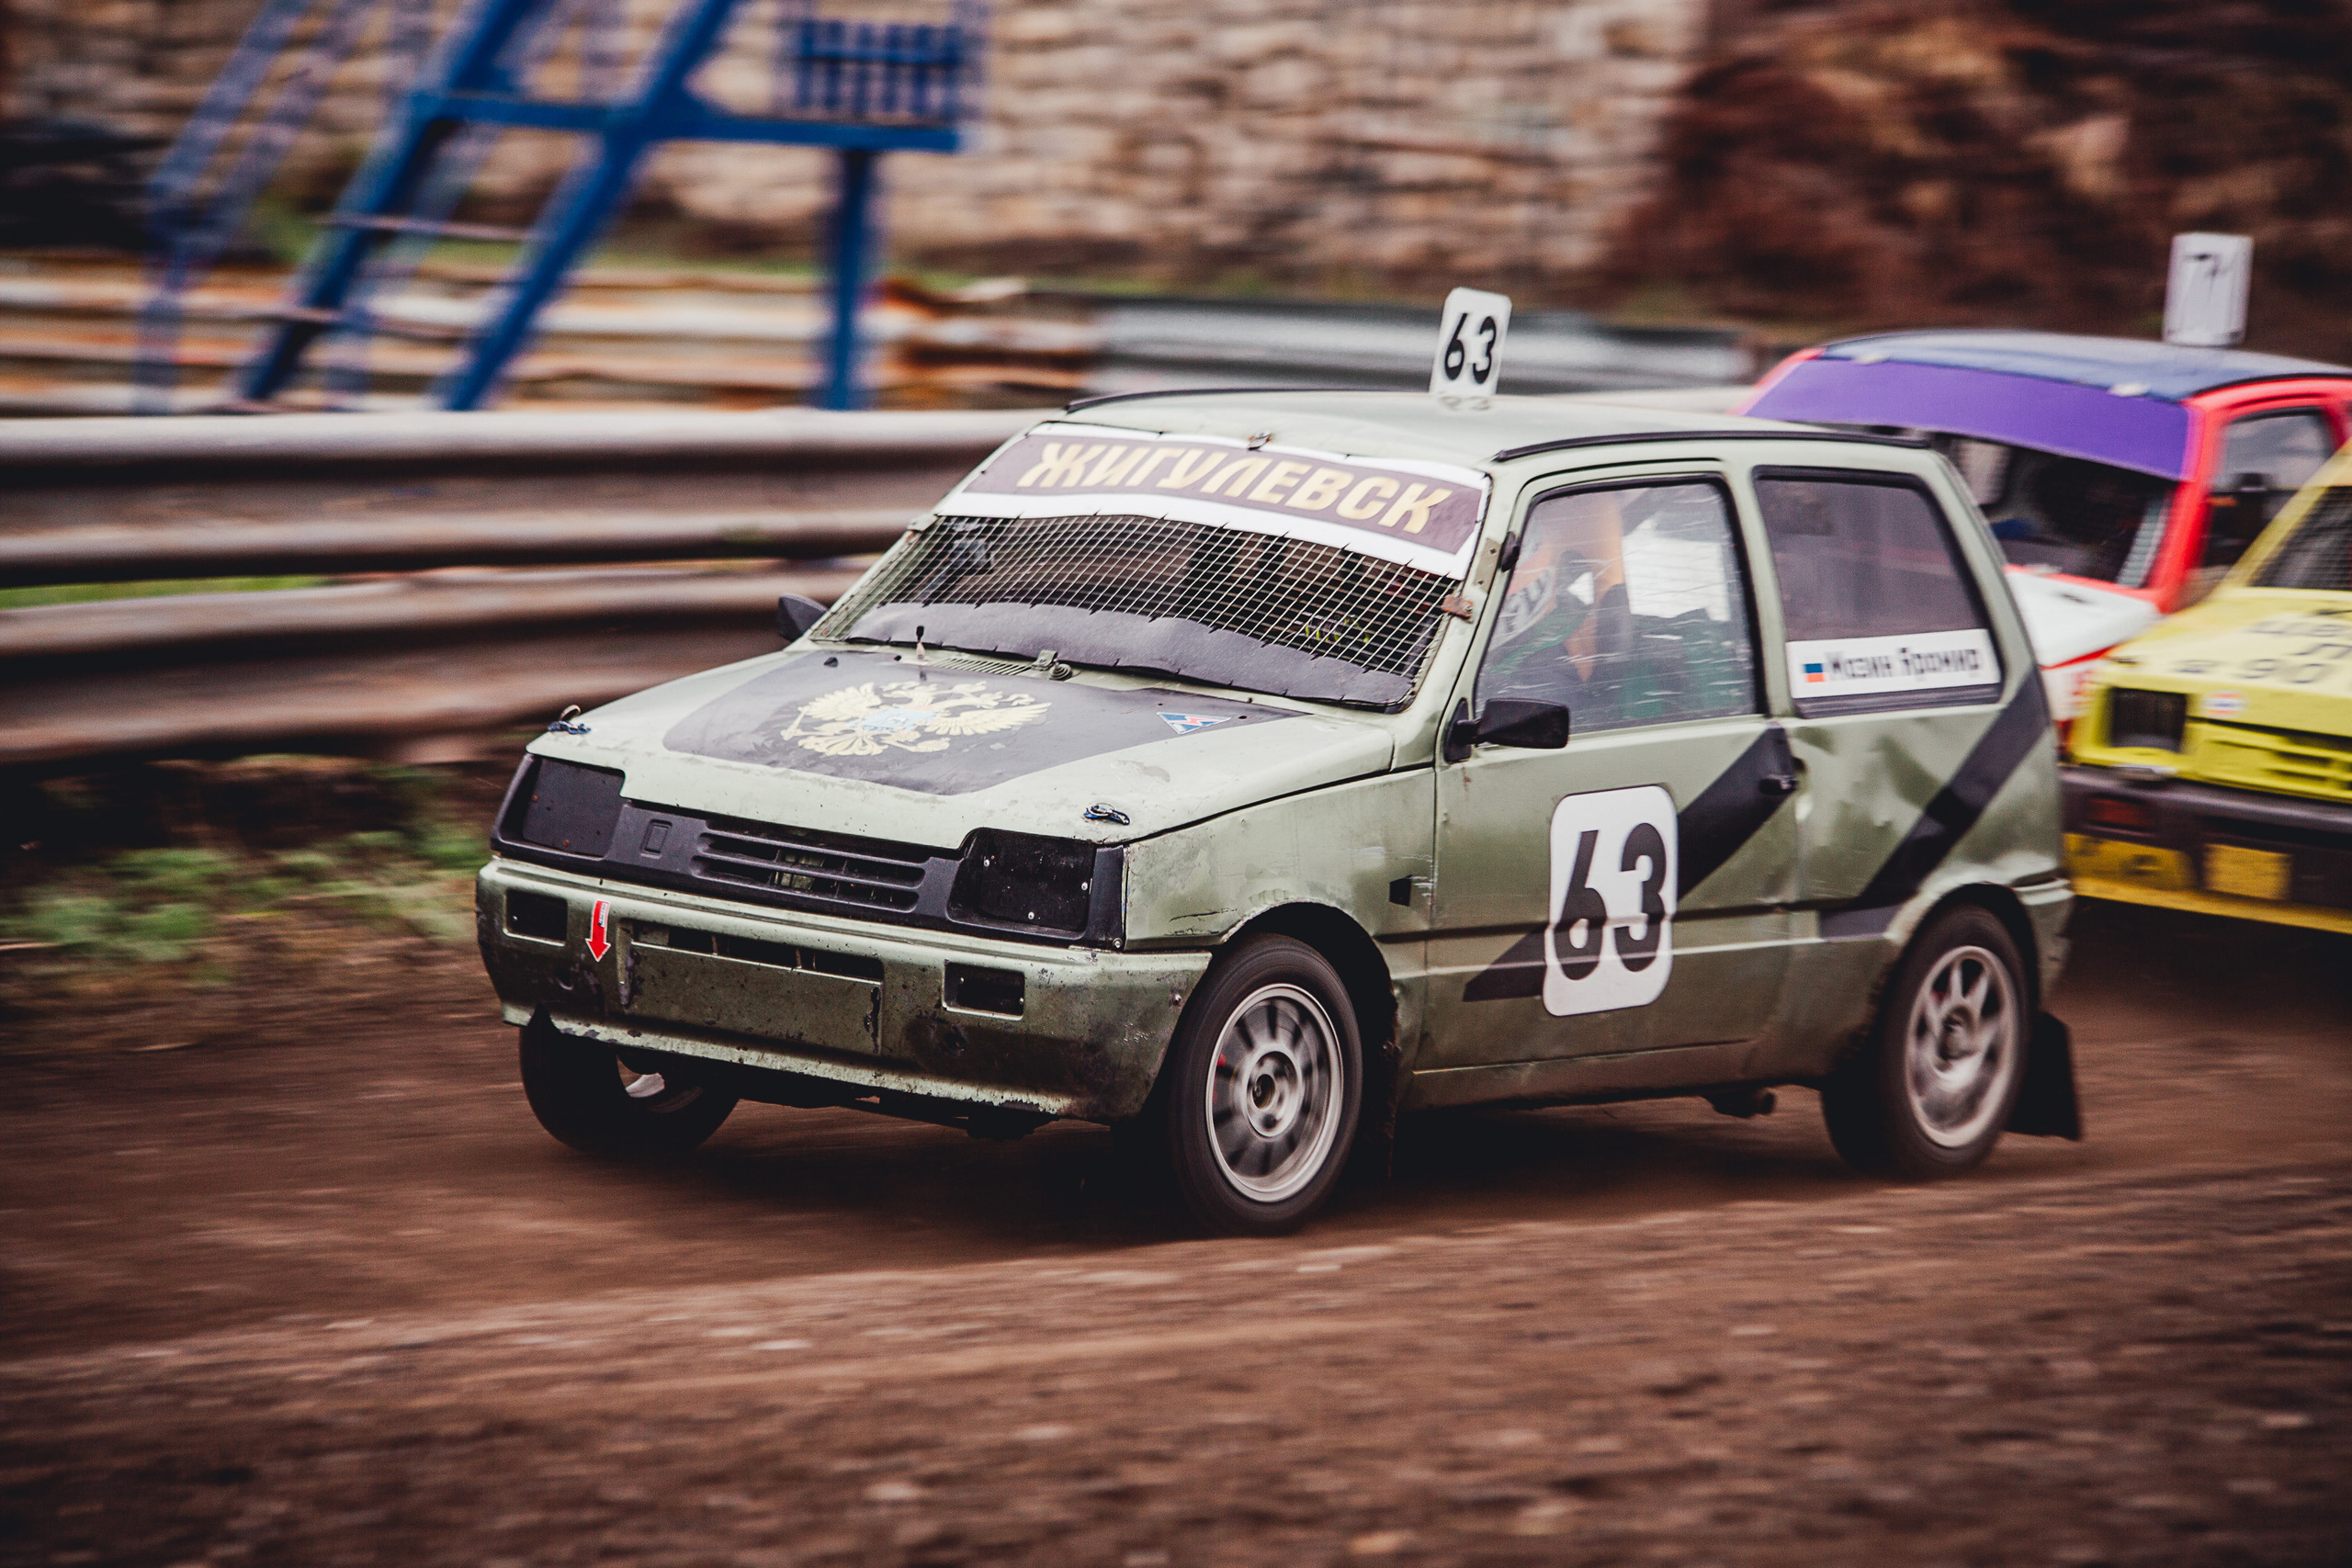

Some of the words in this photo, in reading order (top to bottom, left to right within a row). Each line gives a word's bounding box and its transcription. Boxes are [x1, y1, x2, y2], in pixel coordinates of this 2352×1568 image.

[1444, 312, 1497, 384] 63
[1016, 441, 1453, 534] ЖИГУЛЕВСК
[1553, 822, 1667, 980] 63
